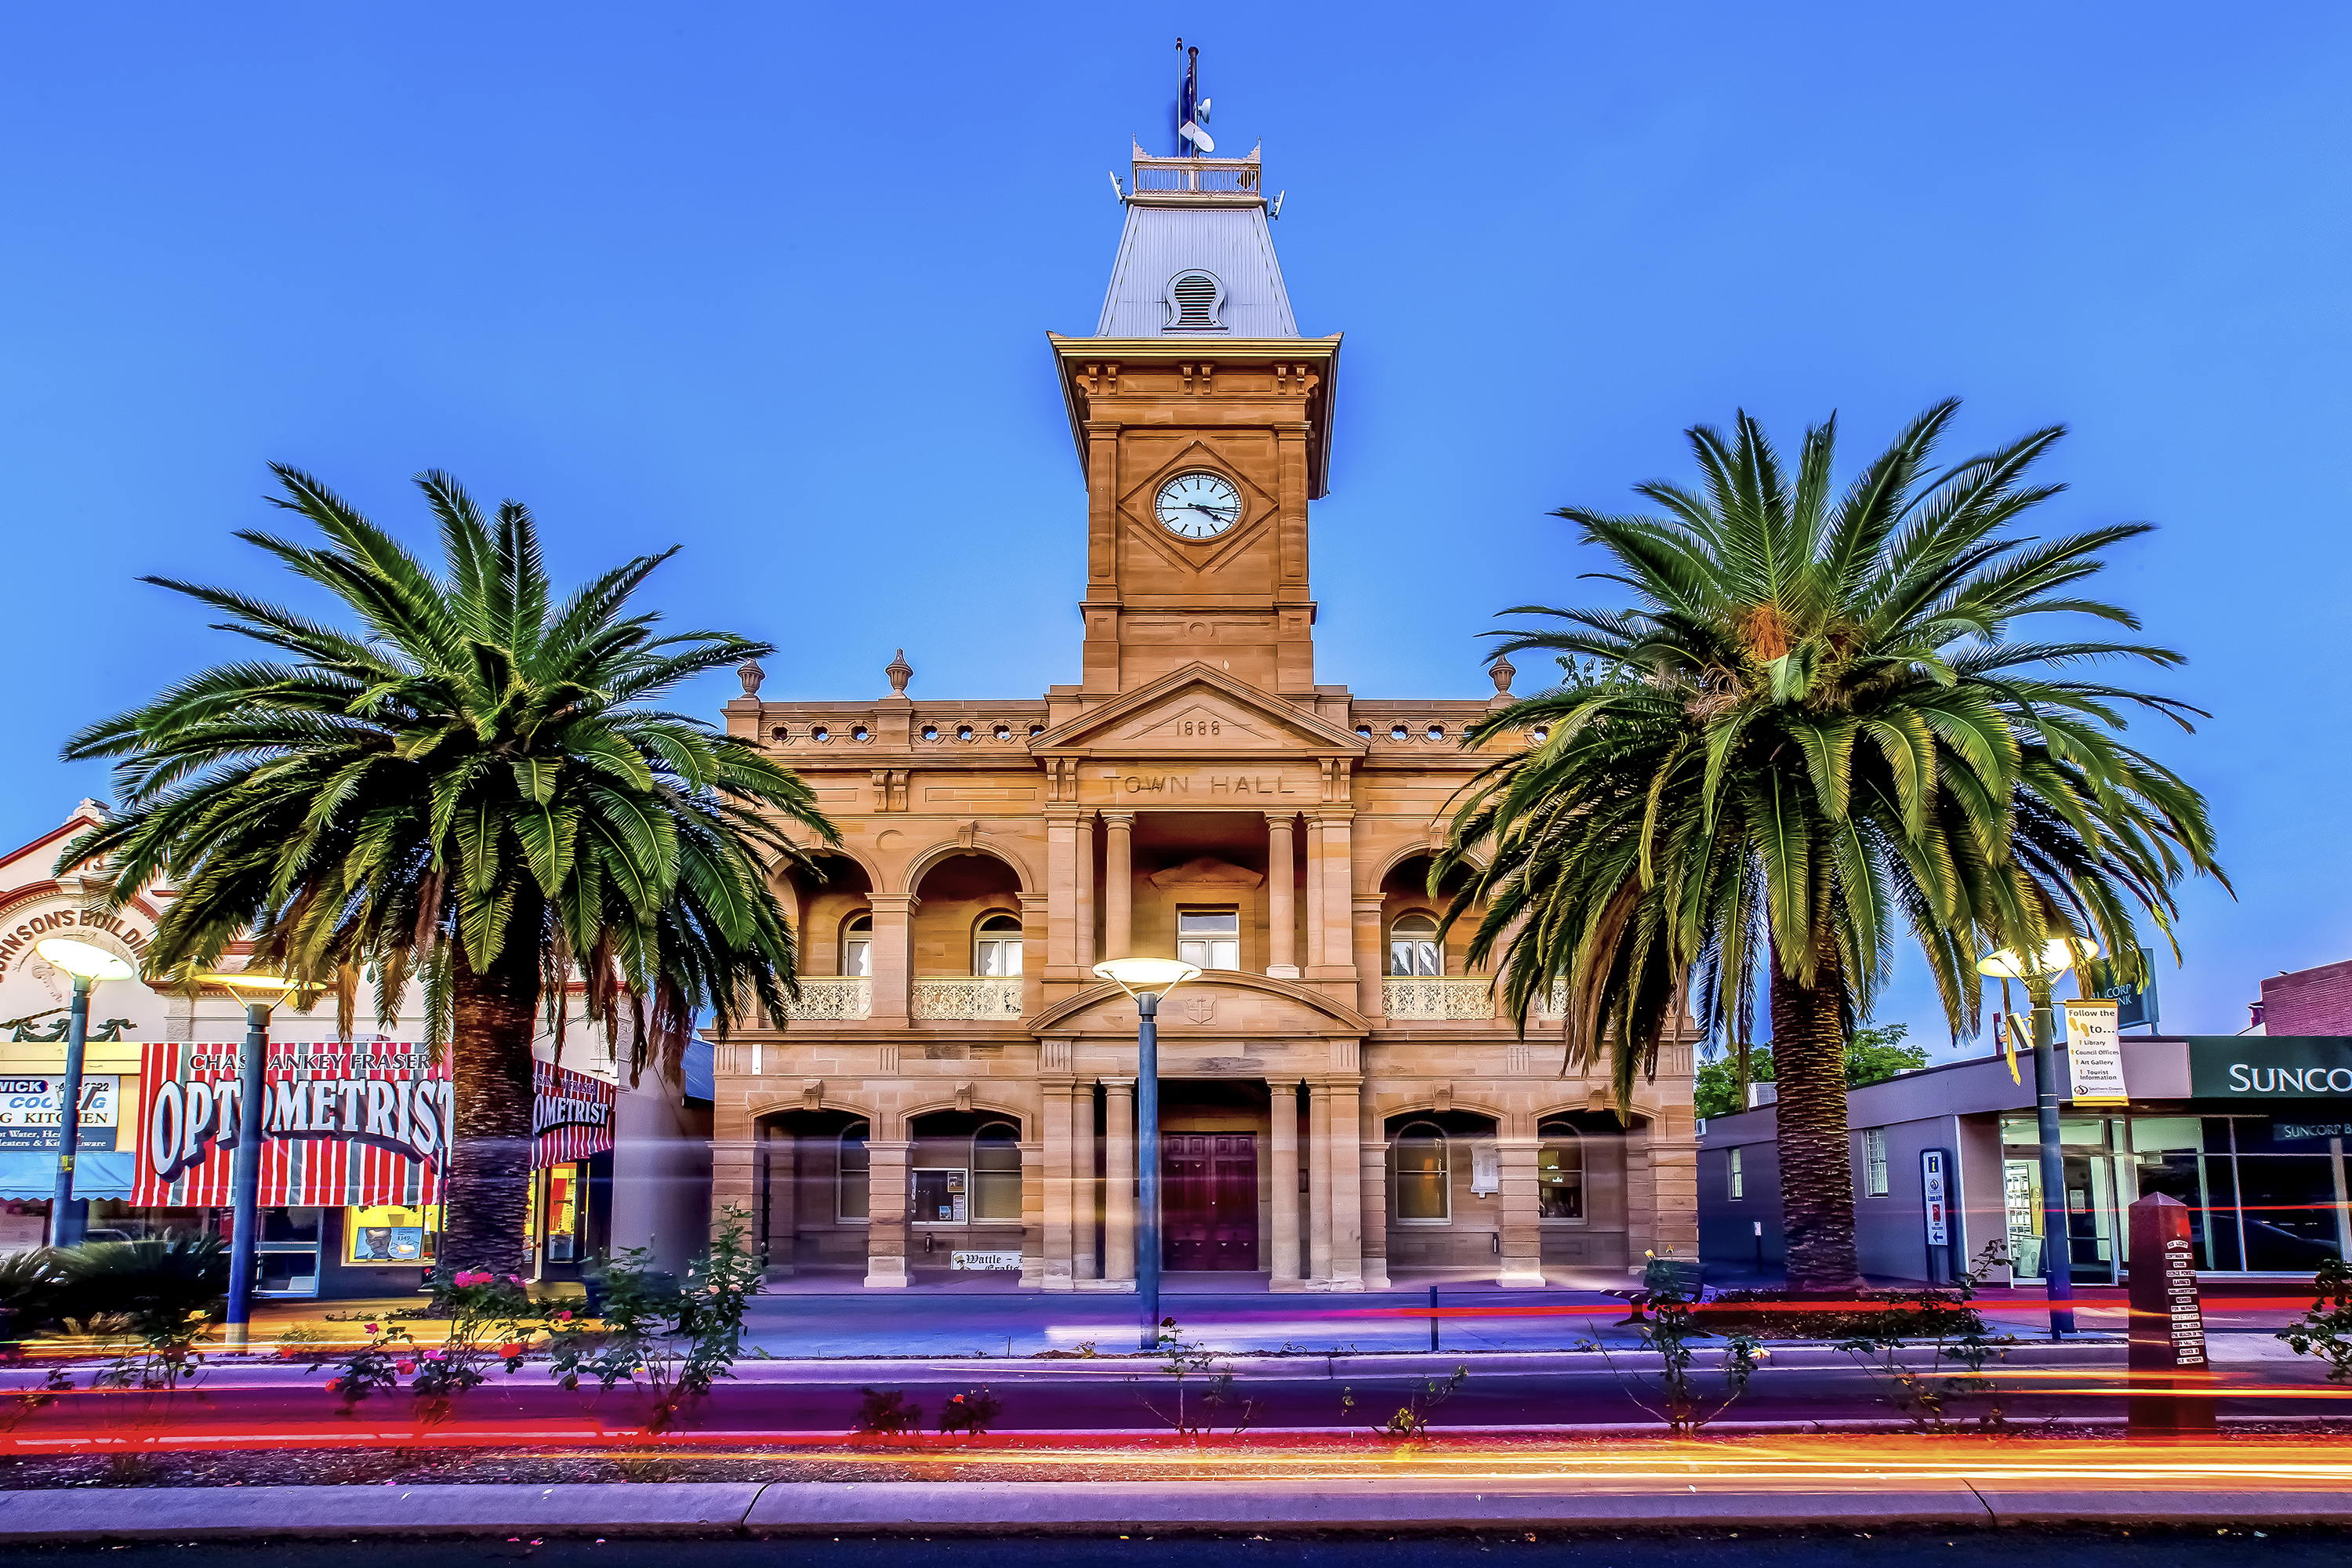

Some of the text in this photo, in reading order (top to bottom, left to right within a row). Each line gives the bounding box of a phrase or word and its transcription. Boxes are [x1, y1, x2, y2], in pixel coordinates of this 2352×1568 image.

[1177, 721, 1220, 735] 1888
[1103, 775, 1295, 793] TOWN HALL
[2090, 1025, 2114, 1033] to...
[267, 1054, 347, 1070] ANKEY
[355, 1054, 432, 1070] FRASER
[2229, 1064, 2352, 1091] SUNCO
[568, 1080, 596, 1094] FRASER
[24, 1113, 108, 1123] KITCEN
[533, 1094, 608, 1133] OMETRIST
[9, 1131, 40, 1139] Water,
[2284, 1125, 2341, 1137] SUNCORP
[966, 1254, 1001, 1264] Wattle
